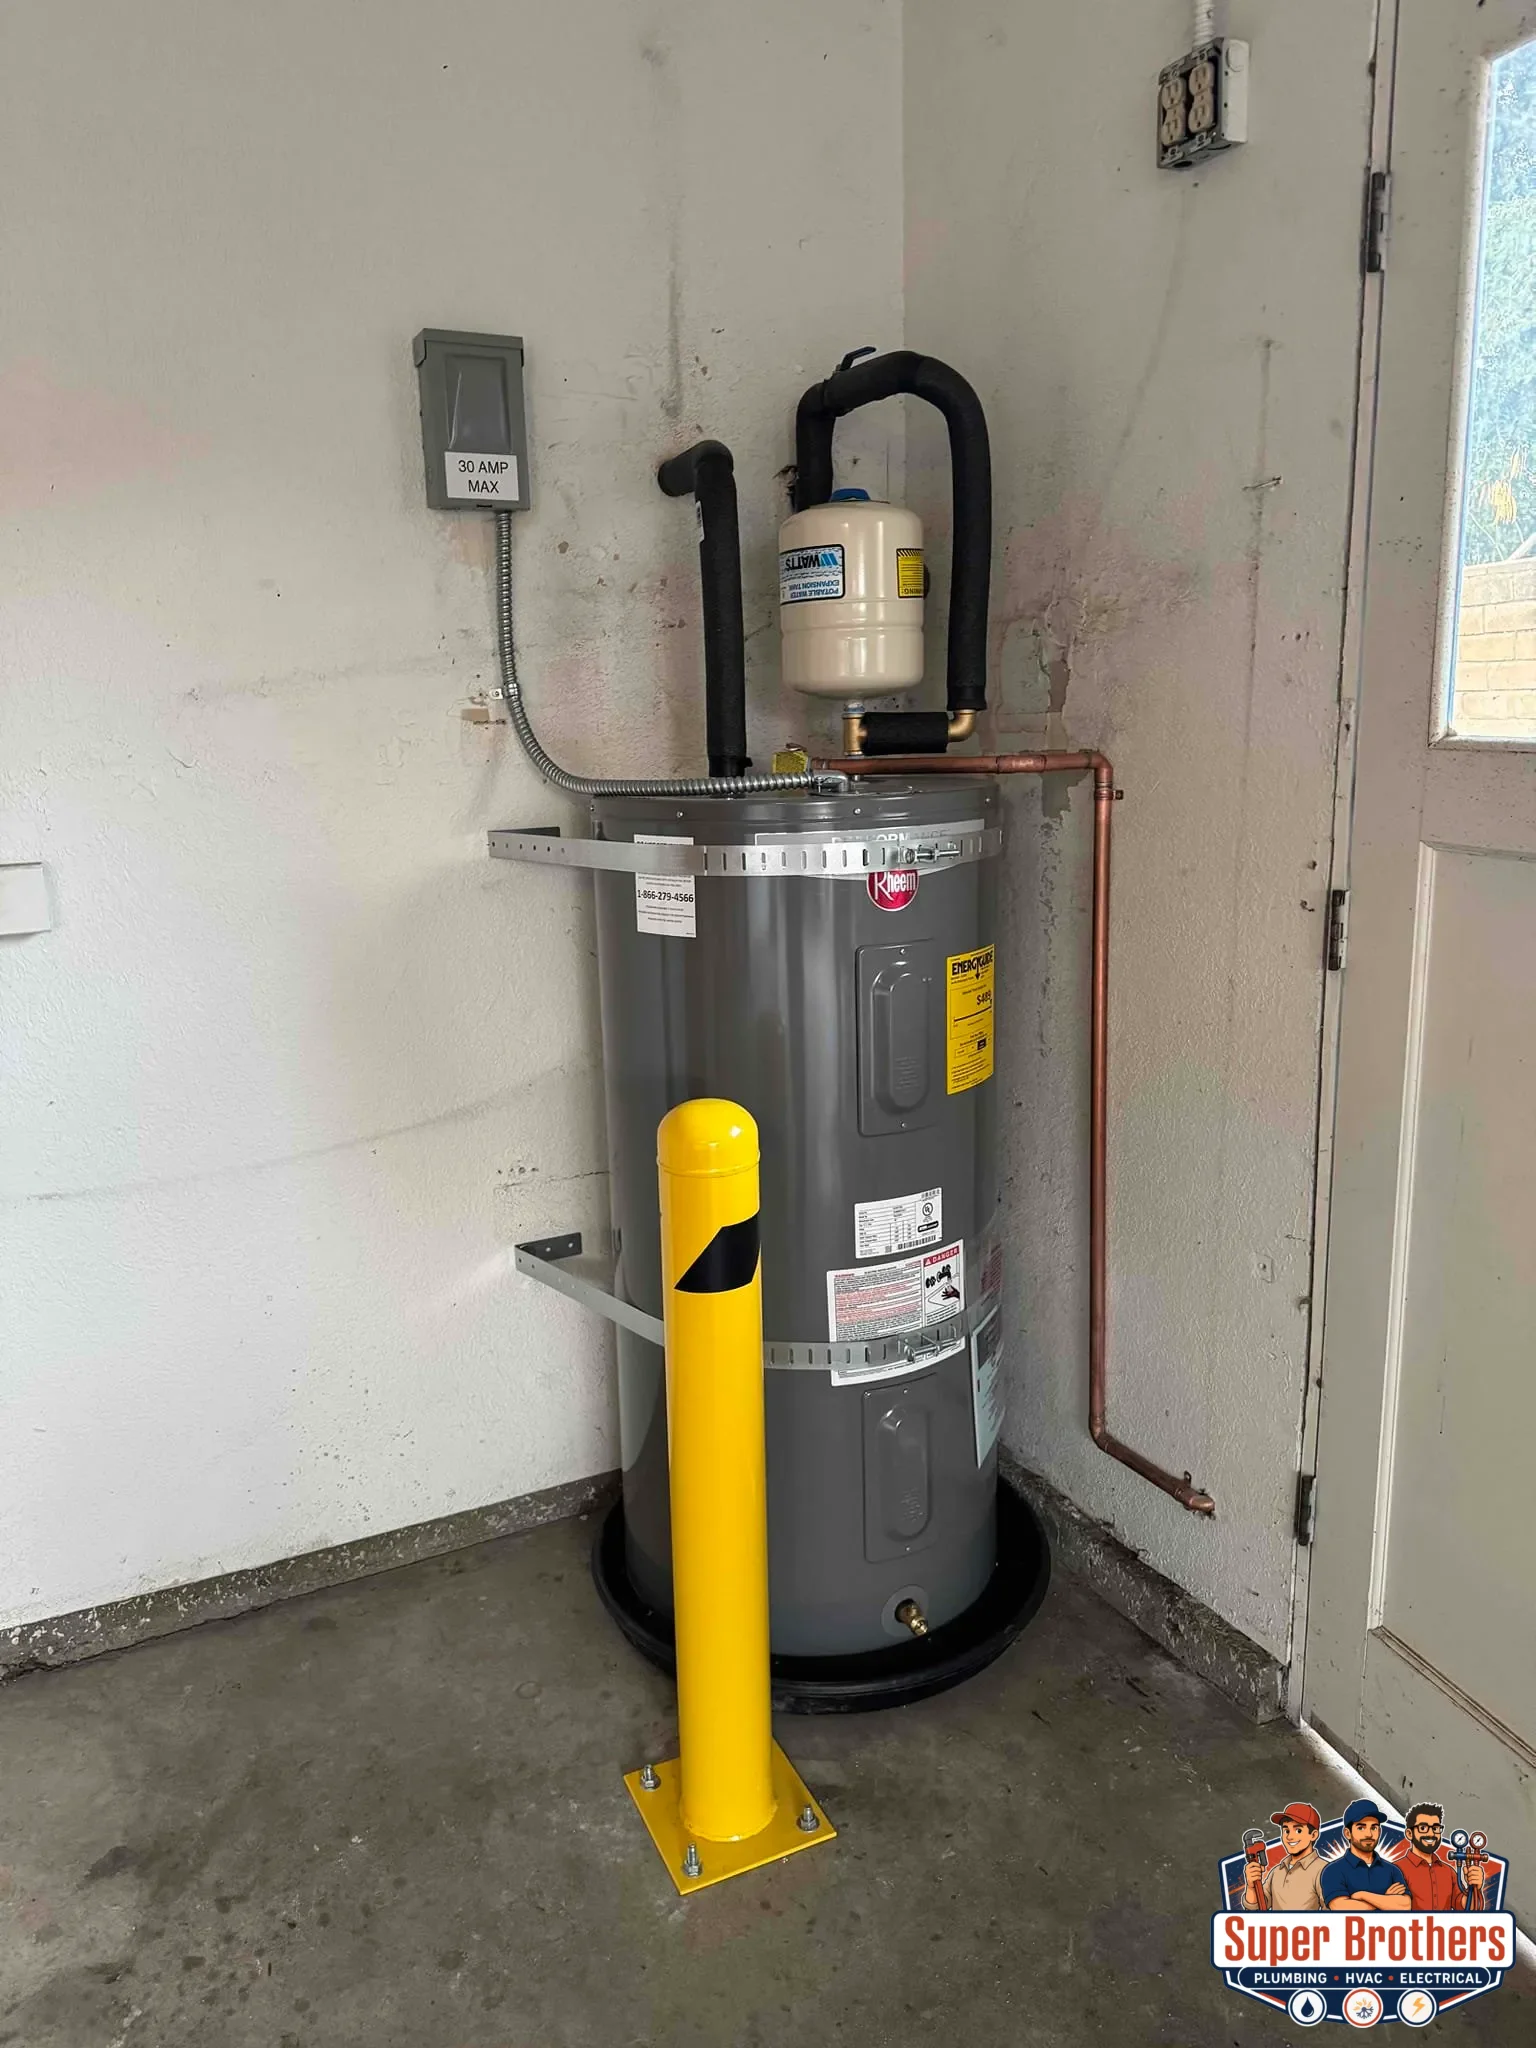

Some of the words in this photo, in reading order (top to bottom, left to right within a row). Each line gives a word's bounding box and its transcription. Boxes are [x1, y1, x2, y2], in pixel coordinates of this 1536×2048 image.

[458, 460, 474, 473] 30
[478, 461, 509, 474] AMP
[468, 480, 500, 494] MAX
[785, 554, 820, 570] WATTS
[802, 580, 839, 590] EXPANSION
[808, 587, 839, 597] POTABLE
[790, 591, 807, 599] WATER
[874, 870, 916, 901] Rheem
[637, 889, 694, 903] 1-866-279-4566
[932, 1248, 959, 1263] DANGER
